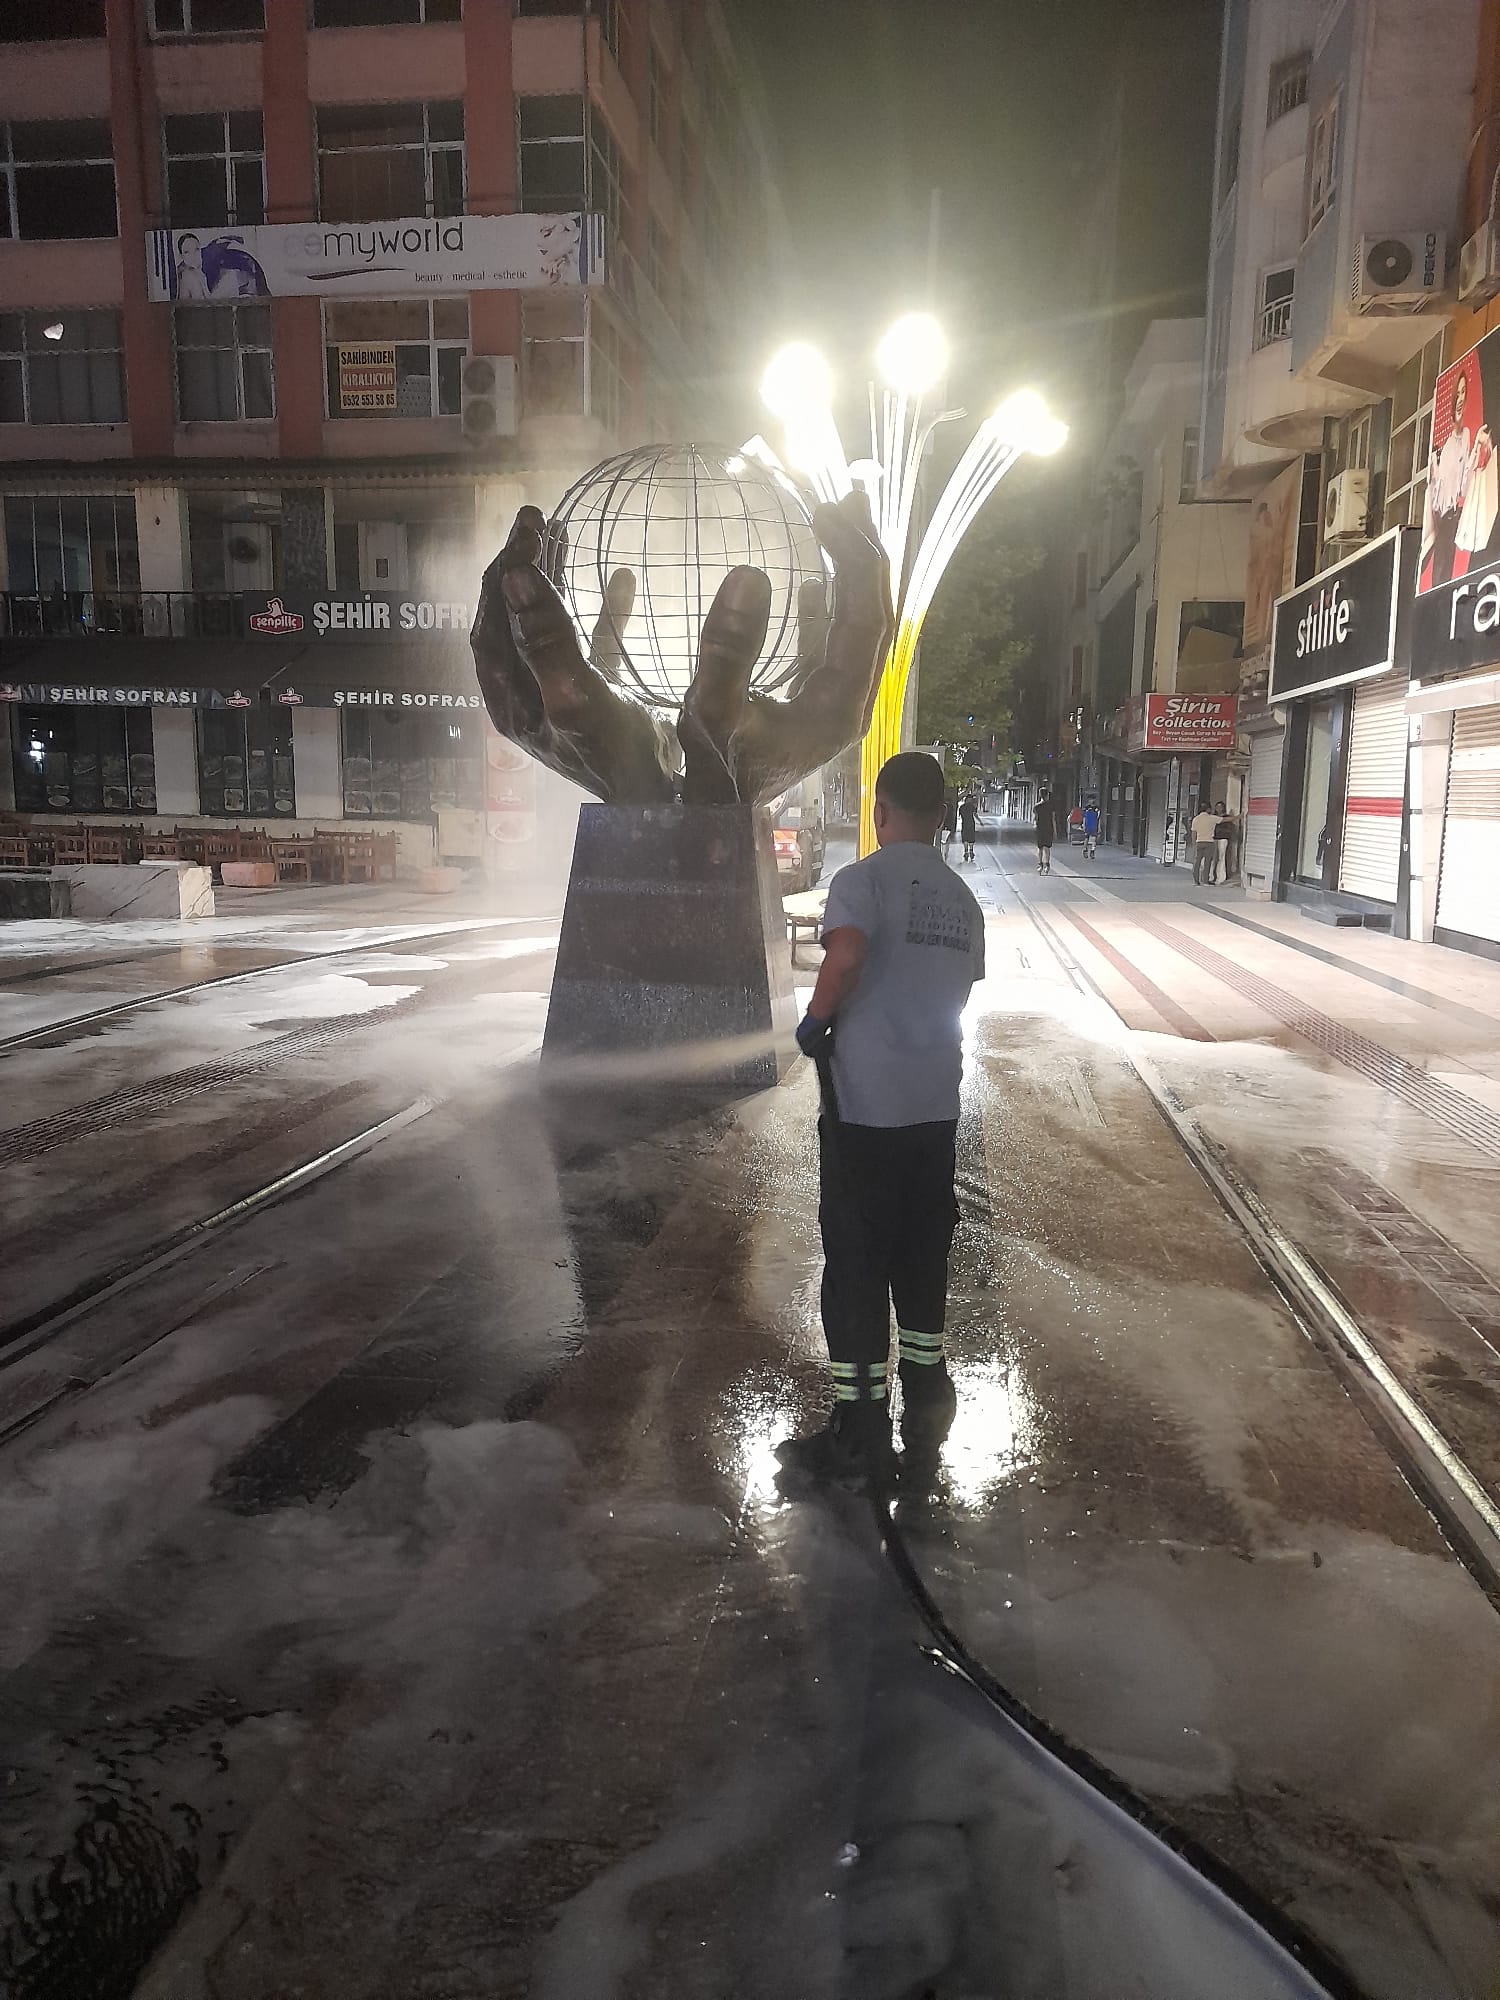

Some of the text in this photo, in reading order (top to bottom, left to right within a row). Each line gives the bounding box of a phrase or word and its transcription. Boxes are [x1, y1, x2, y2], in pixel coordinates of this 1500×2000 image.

[452, 270, 485, 281] medical
[493, 269, 528, 280] esthetic
[312, 593, 474, 636] ŞEHİR SOFR
[1296, 580, 1351, 660] stilife
[50, 686, 198, 704] ŞEHİR SOFRASI
[333, 689, 395, 707] ŞEHİR
[1165, 697, 1221, 717] Şirin
[1152, 715, 1231, 728] Collection
